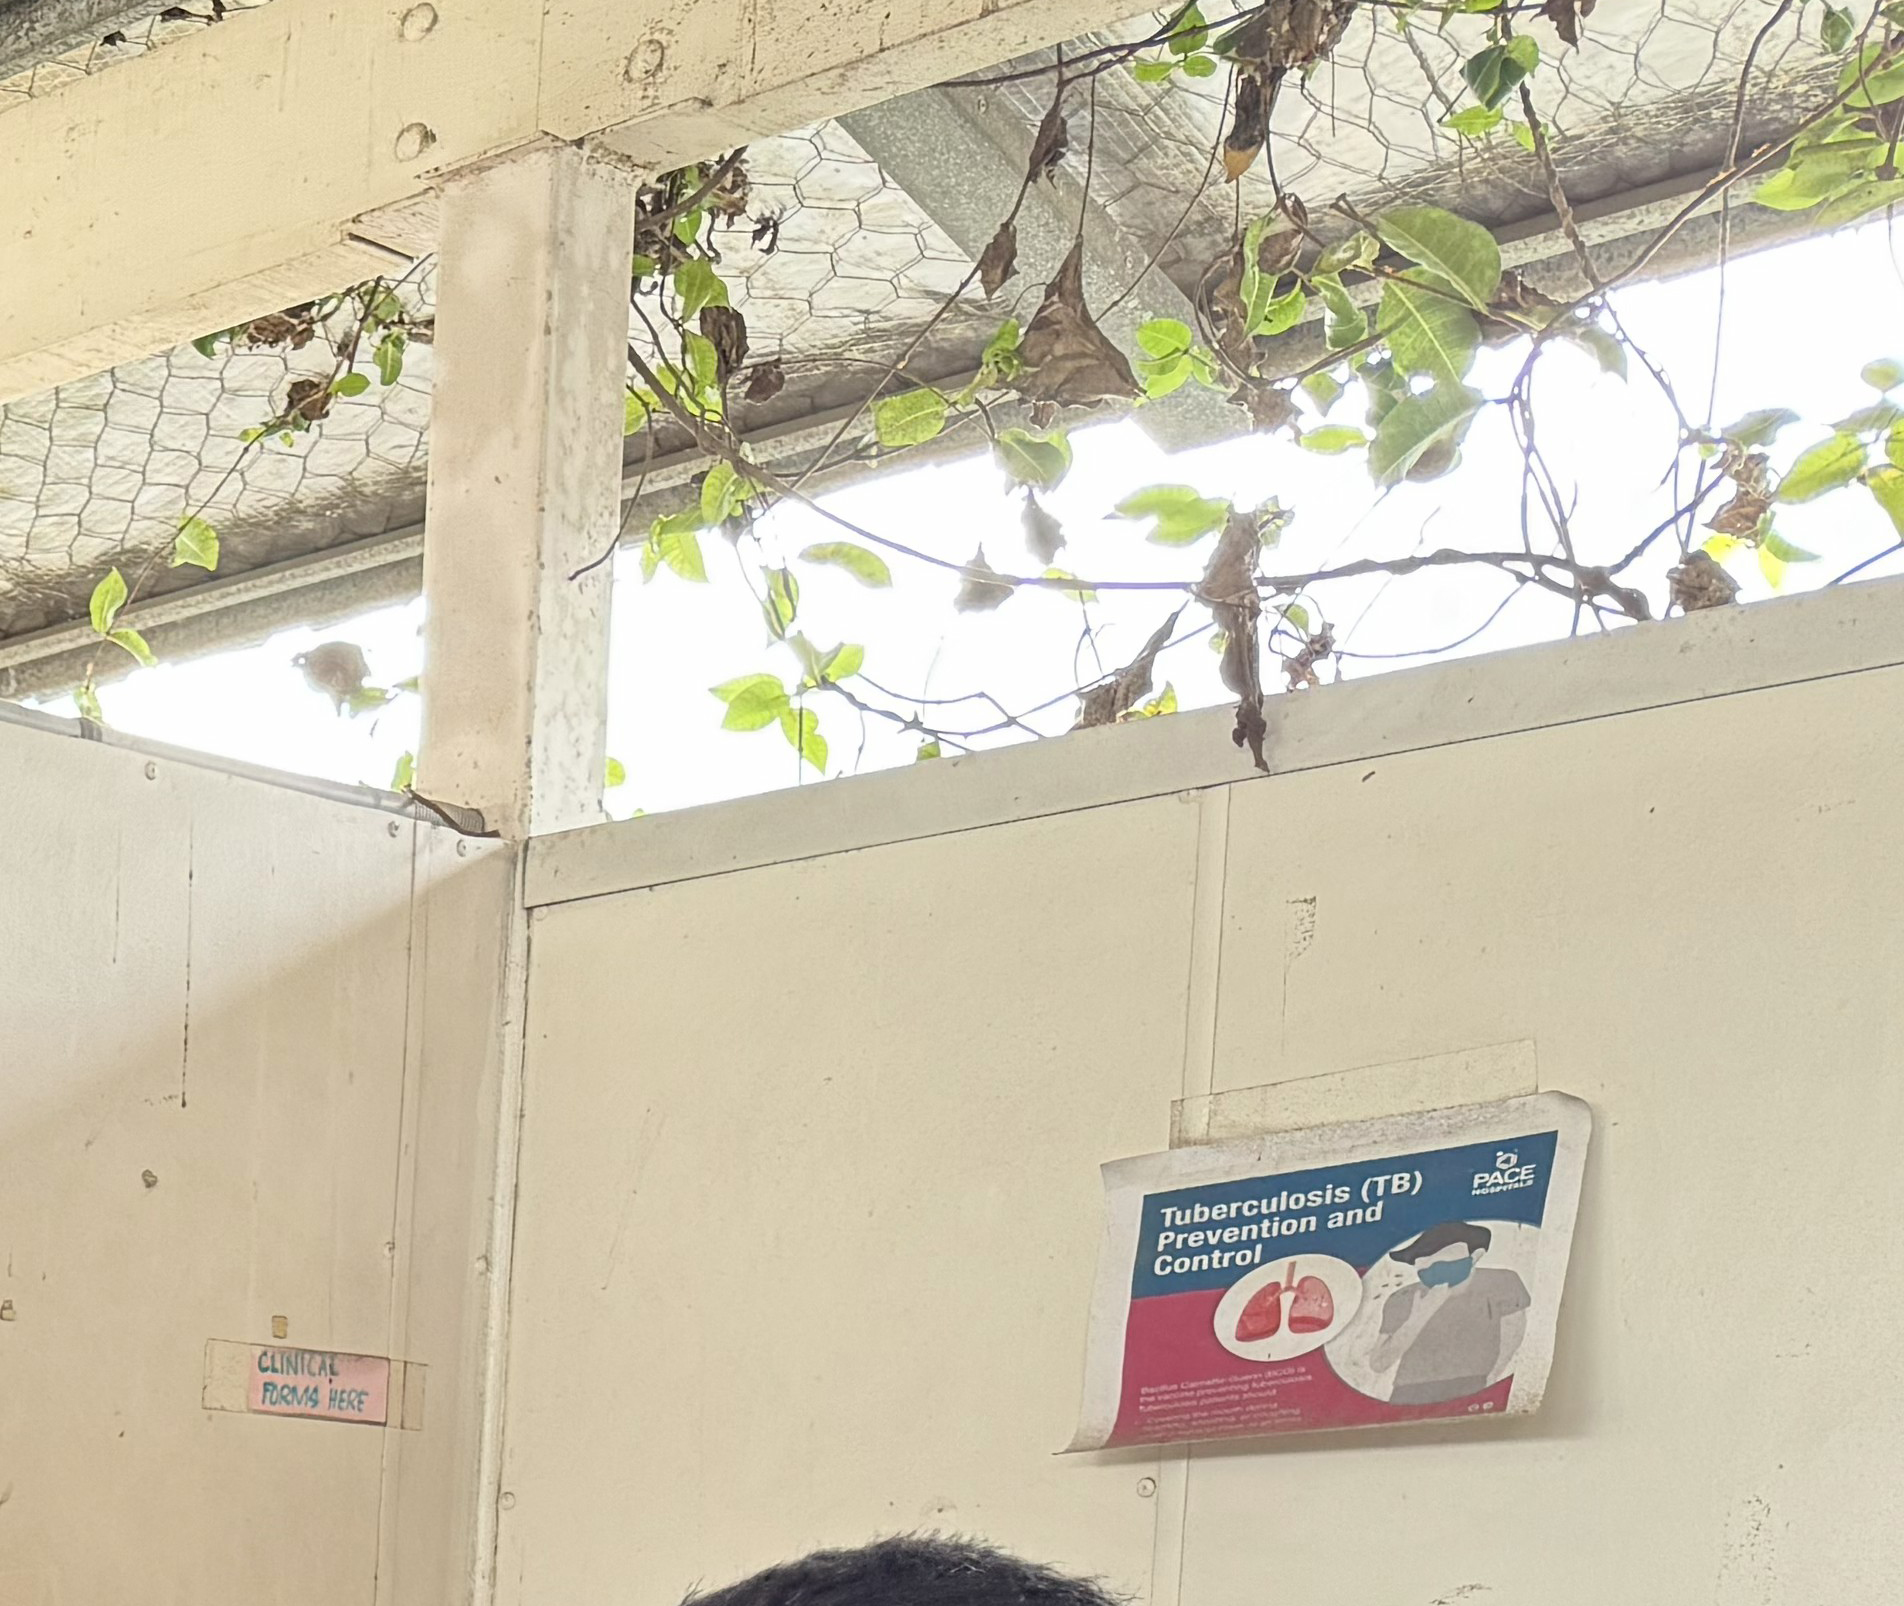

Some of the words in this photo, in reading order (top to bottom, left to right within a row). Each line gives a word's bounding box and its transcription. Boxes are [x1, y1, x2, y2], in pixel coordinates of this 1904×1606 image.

[1472, 1163, 1535, 1187] PACE
[1160, 1185, 1351, 1228] Tuberculosis
[1361, 1171, 1423, 1206] (TB)
[1157, 1216, 1317, 1252] Prevention
[1326, 1199, 1384, 1229] and
[1154, 1244, 1261, 1276] Control
[258, 1350, 340, 1377] CLINICAL
[261, 1381, 319, 1408] FORMS
[328, 1389, 369, 1412] HERE
